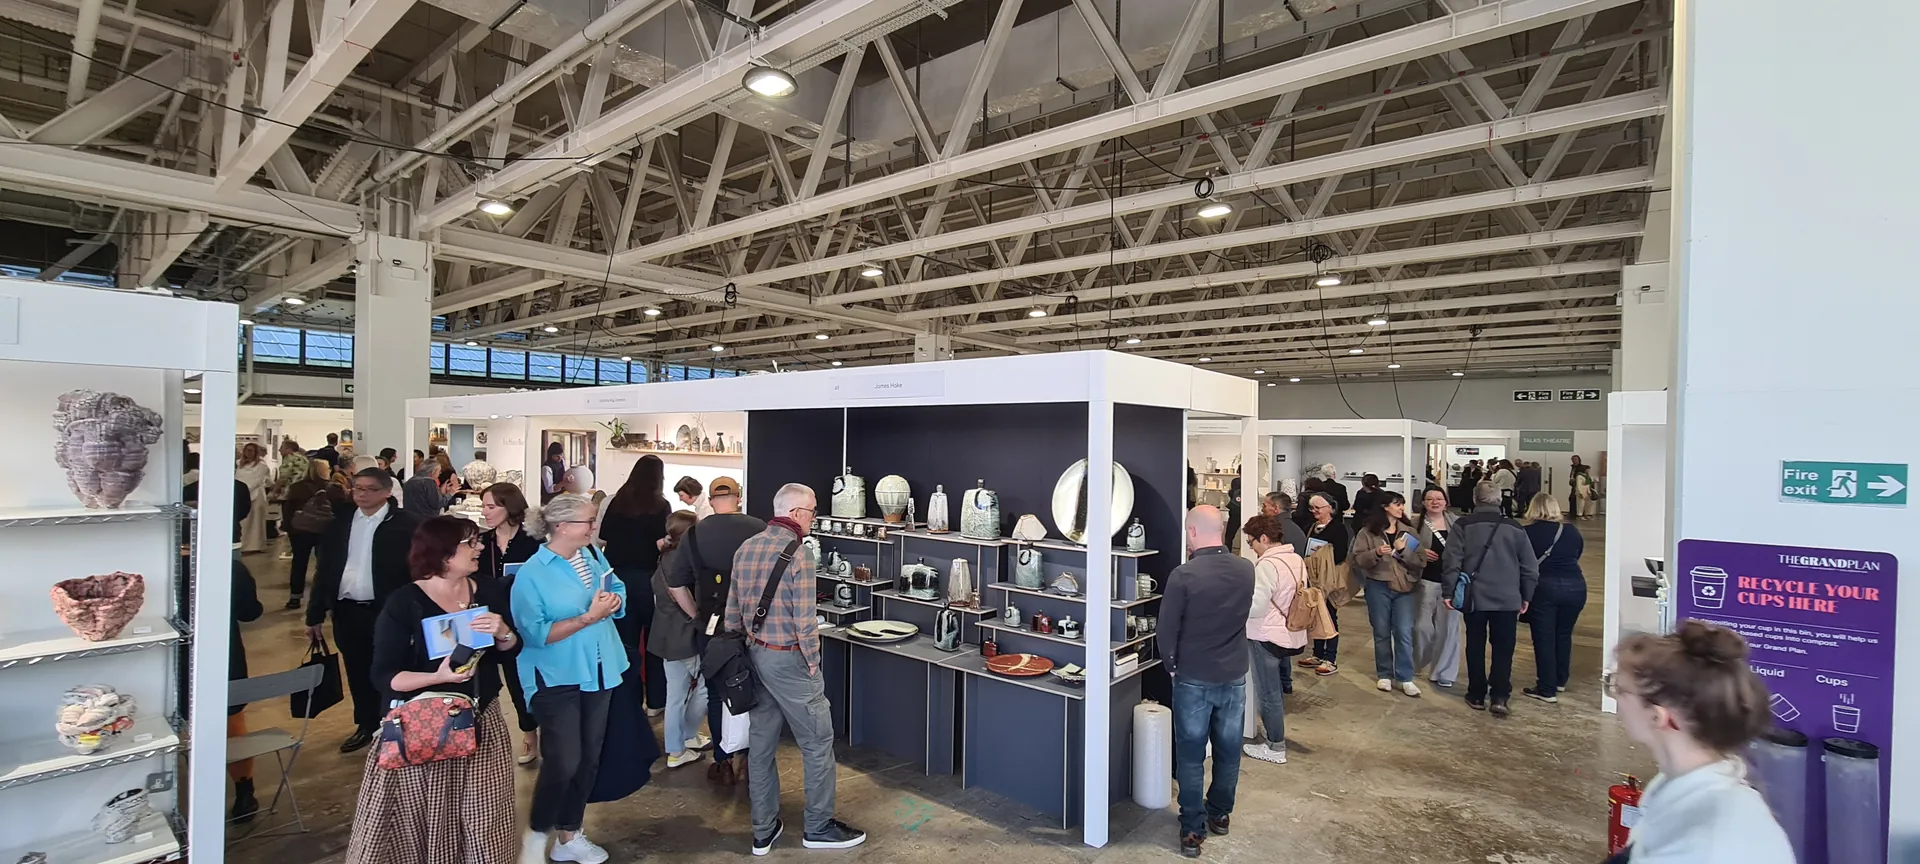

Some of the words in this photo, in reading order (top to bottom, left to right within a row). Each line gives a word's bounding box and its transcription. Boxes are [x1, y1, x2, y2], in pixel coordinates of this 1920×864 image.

[874, 382, 890, 390] James
[1783, 468, 1819, 481] Fire
[1783, 484, 1818, 496] exit
[1737, 576, 1821, 596] RECYCLE
[1824, 583, 1880, 601] YOUR
[1737, 591, 1785, 608] CUPS
[1788, 596, 1840, 614] HERE
[1764, 633, 1784, 641] cups
[1801, 638, 1840, 648] compost.
[1799, 629, 1814, 637] bin,
[1847, 635, 1867, 643] help
[1763, 643, 1788, 652] Grand
[1788, 646, 1809, 655] Plan.
[1750, 664, 1785, 678] Liquid
[1815, 674, 1849, 687] Cups
